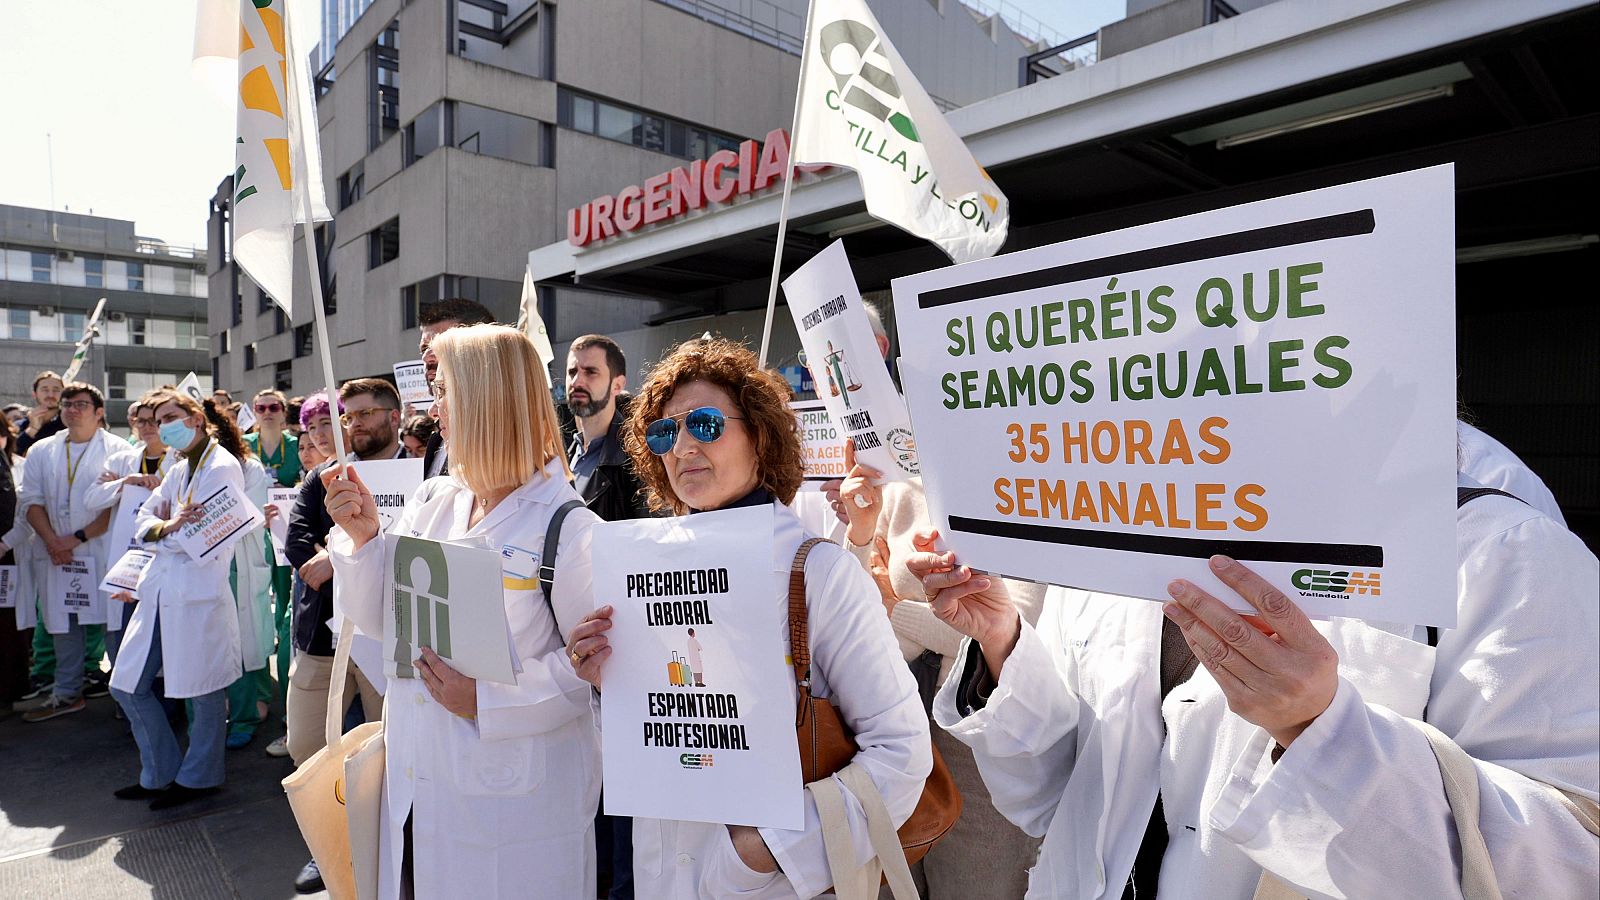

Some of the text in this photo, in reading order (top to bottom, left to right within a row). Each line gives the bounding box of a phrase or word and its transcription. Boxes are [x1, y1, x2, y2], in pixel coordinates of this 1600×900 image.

[567, 128, 836, 247] URGENCIA
[911, 165, 928, 185] y
[946, 261, 1326, 357] SI QUERÉIS QUE
[941, 335, 1353, 410] SEAMOS IGUALES
[802, 411, 833, 426] PRIM
[1006, 416, 1232, 465] 35 HORAS
[215, 491, 231, 506] QUE
[993, 476, 1269, 532] SEMANALES
[184, 497, 238, 539] SEAMOS IGUALES
[204, 517, 243, 548] SEMANALES
[210, 513, 234, 531] HORAS
[626, 567, 730, 598] PRECARIEDAD
[1291, 568, 1381, 596] CESM
[1299, 591, 1350, 600] Valladolid
[646, 599, 713, 626] LABORAL
[647, 692, 739, 719] ESPANTADA
[643, 721, 750, 751] PROFESIONAL
[680, 753, 713, 766] CESM
